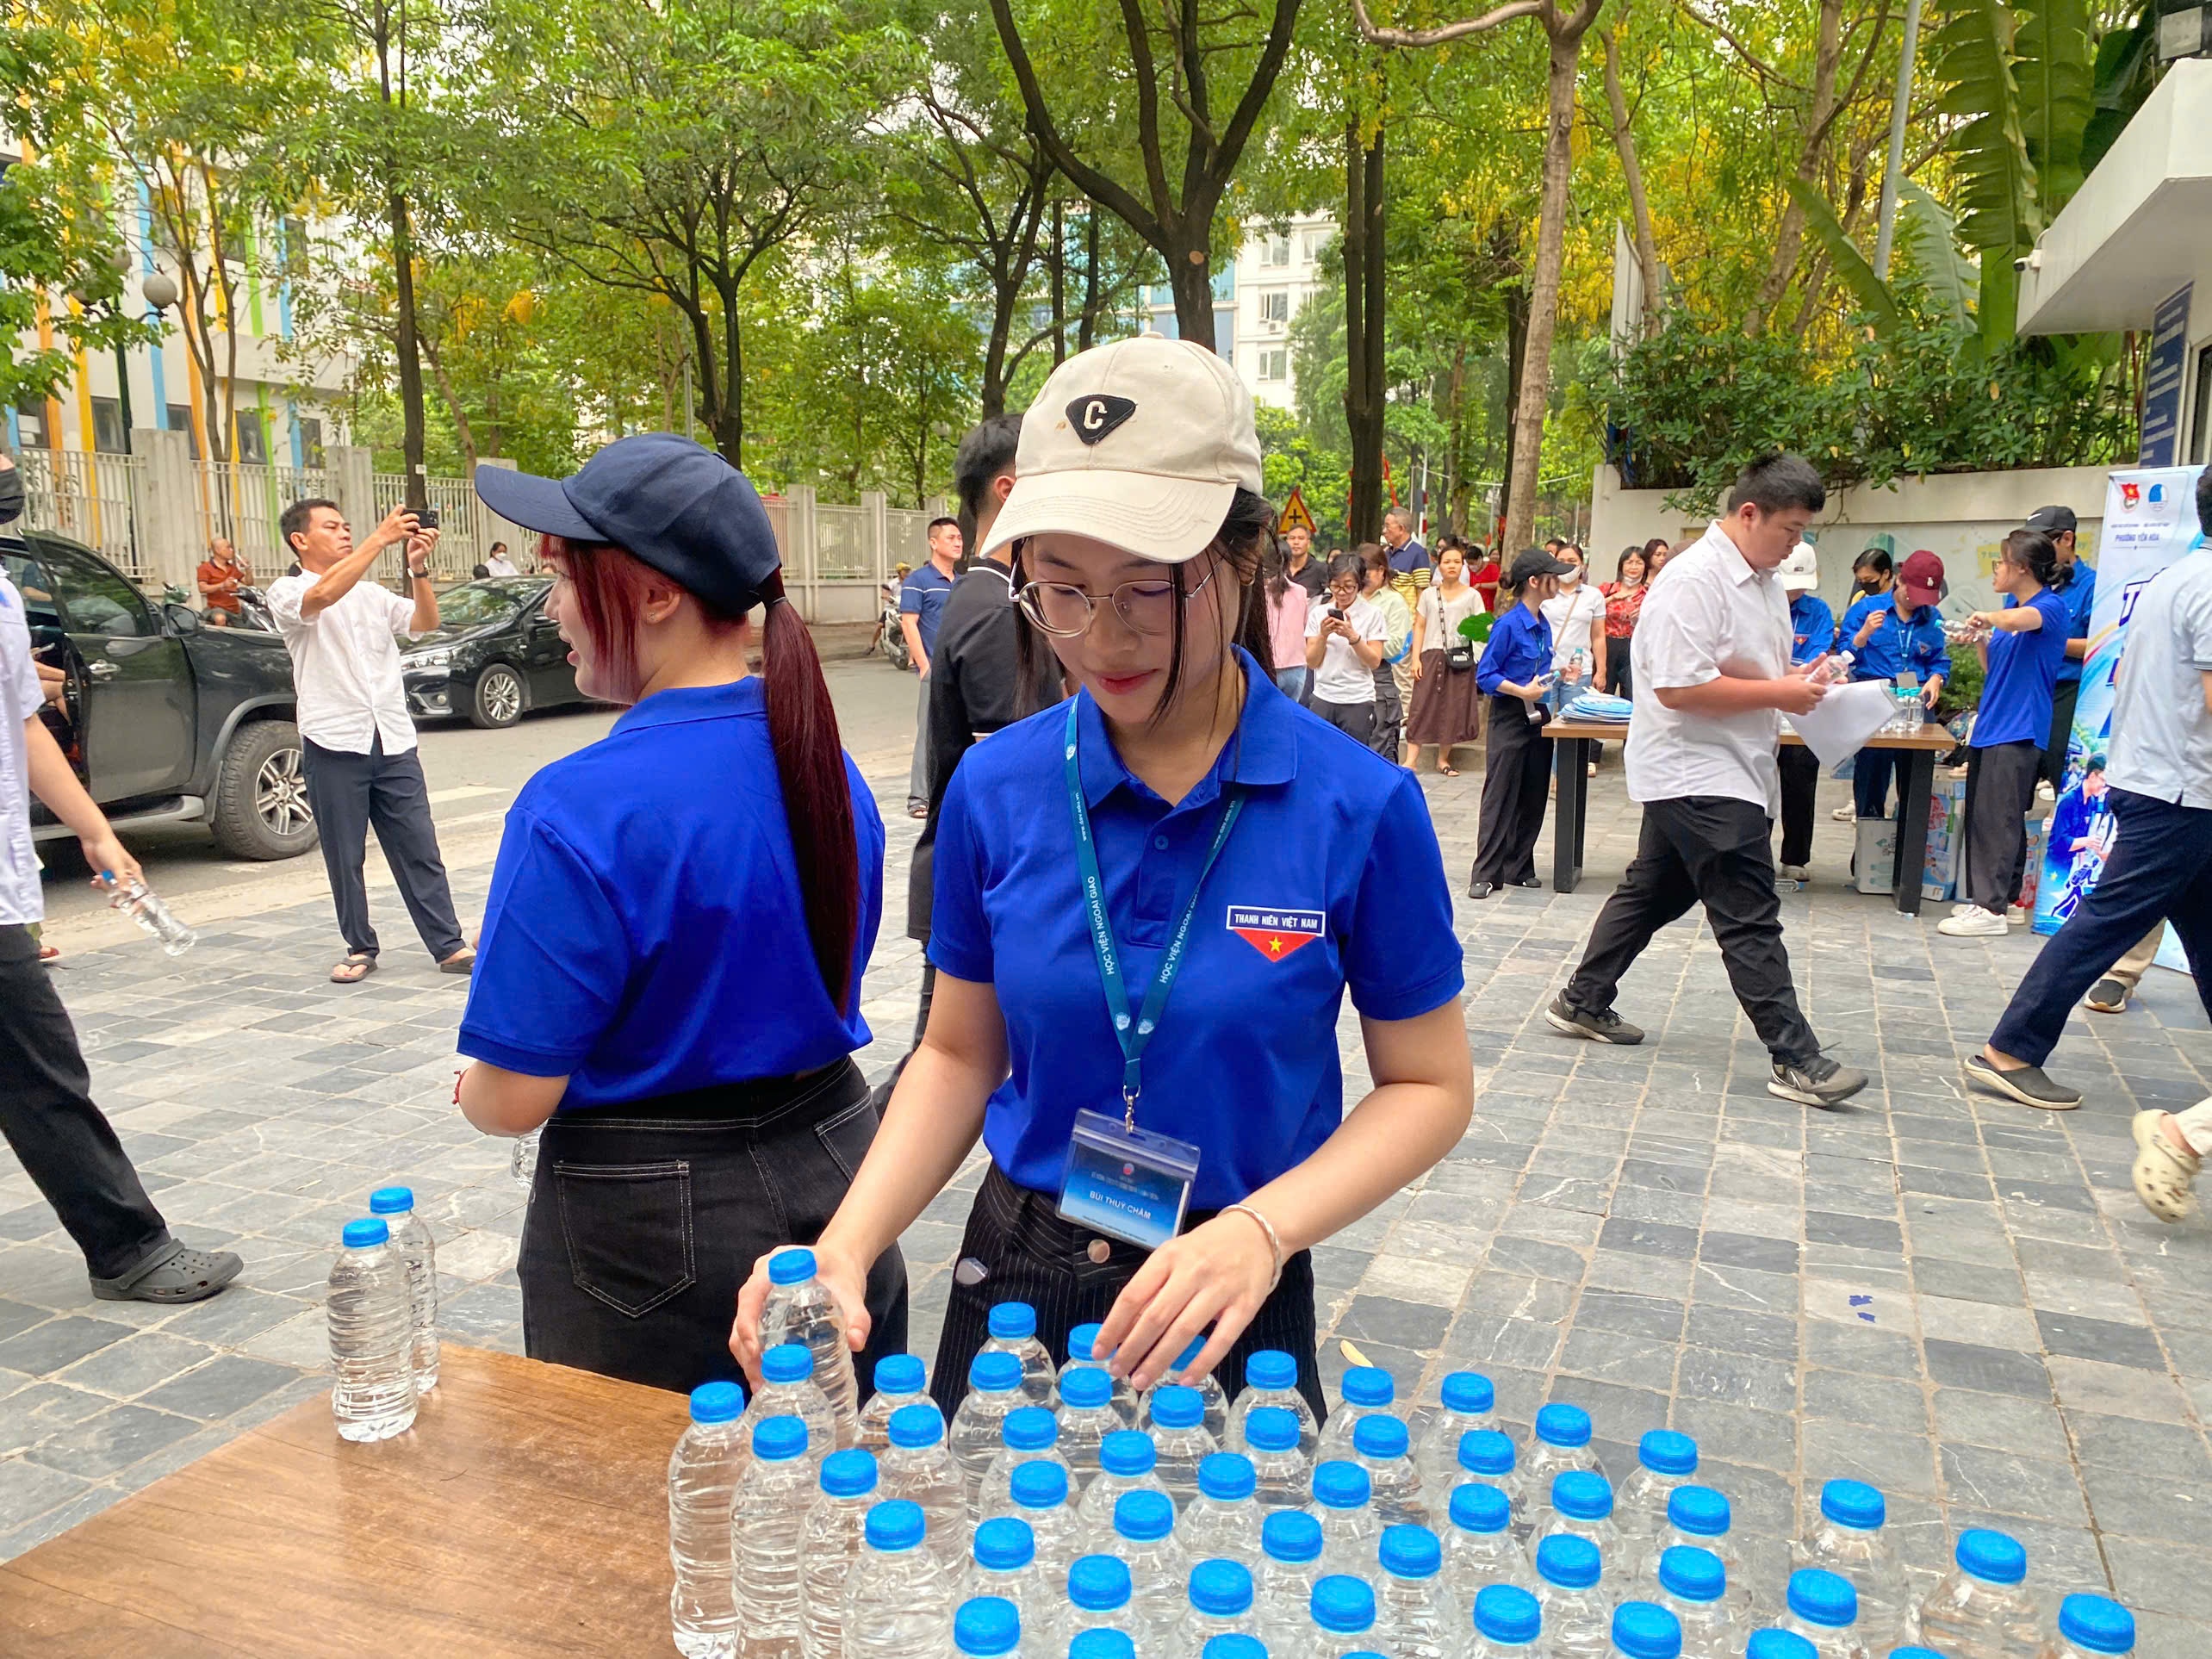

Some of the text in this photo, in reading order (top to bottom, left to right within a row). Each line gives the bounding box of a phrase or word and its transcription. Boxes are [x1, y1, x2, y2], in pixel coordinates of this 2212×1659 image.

[1084, 401, 1108, 430] C
[1087, 876, 1115, 975] HỌC VIỆN NGOẠI GIAO
[1234, 913, 1318, 929] THANH NIÊN VIỆT NAM
[1159, 962, 1173, 984] HỌC
[1167, 940, 1182, 961] VIỆN
